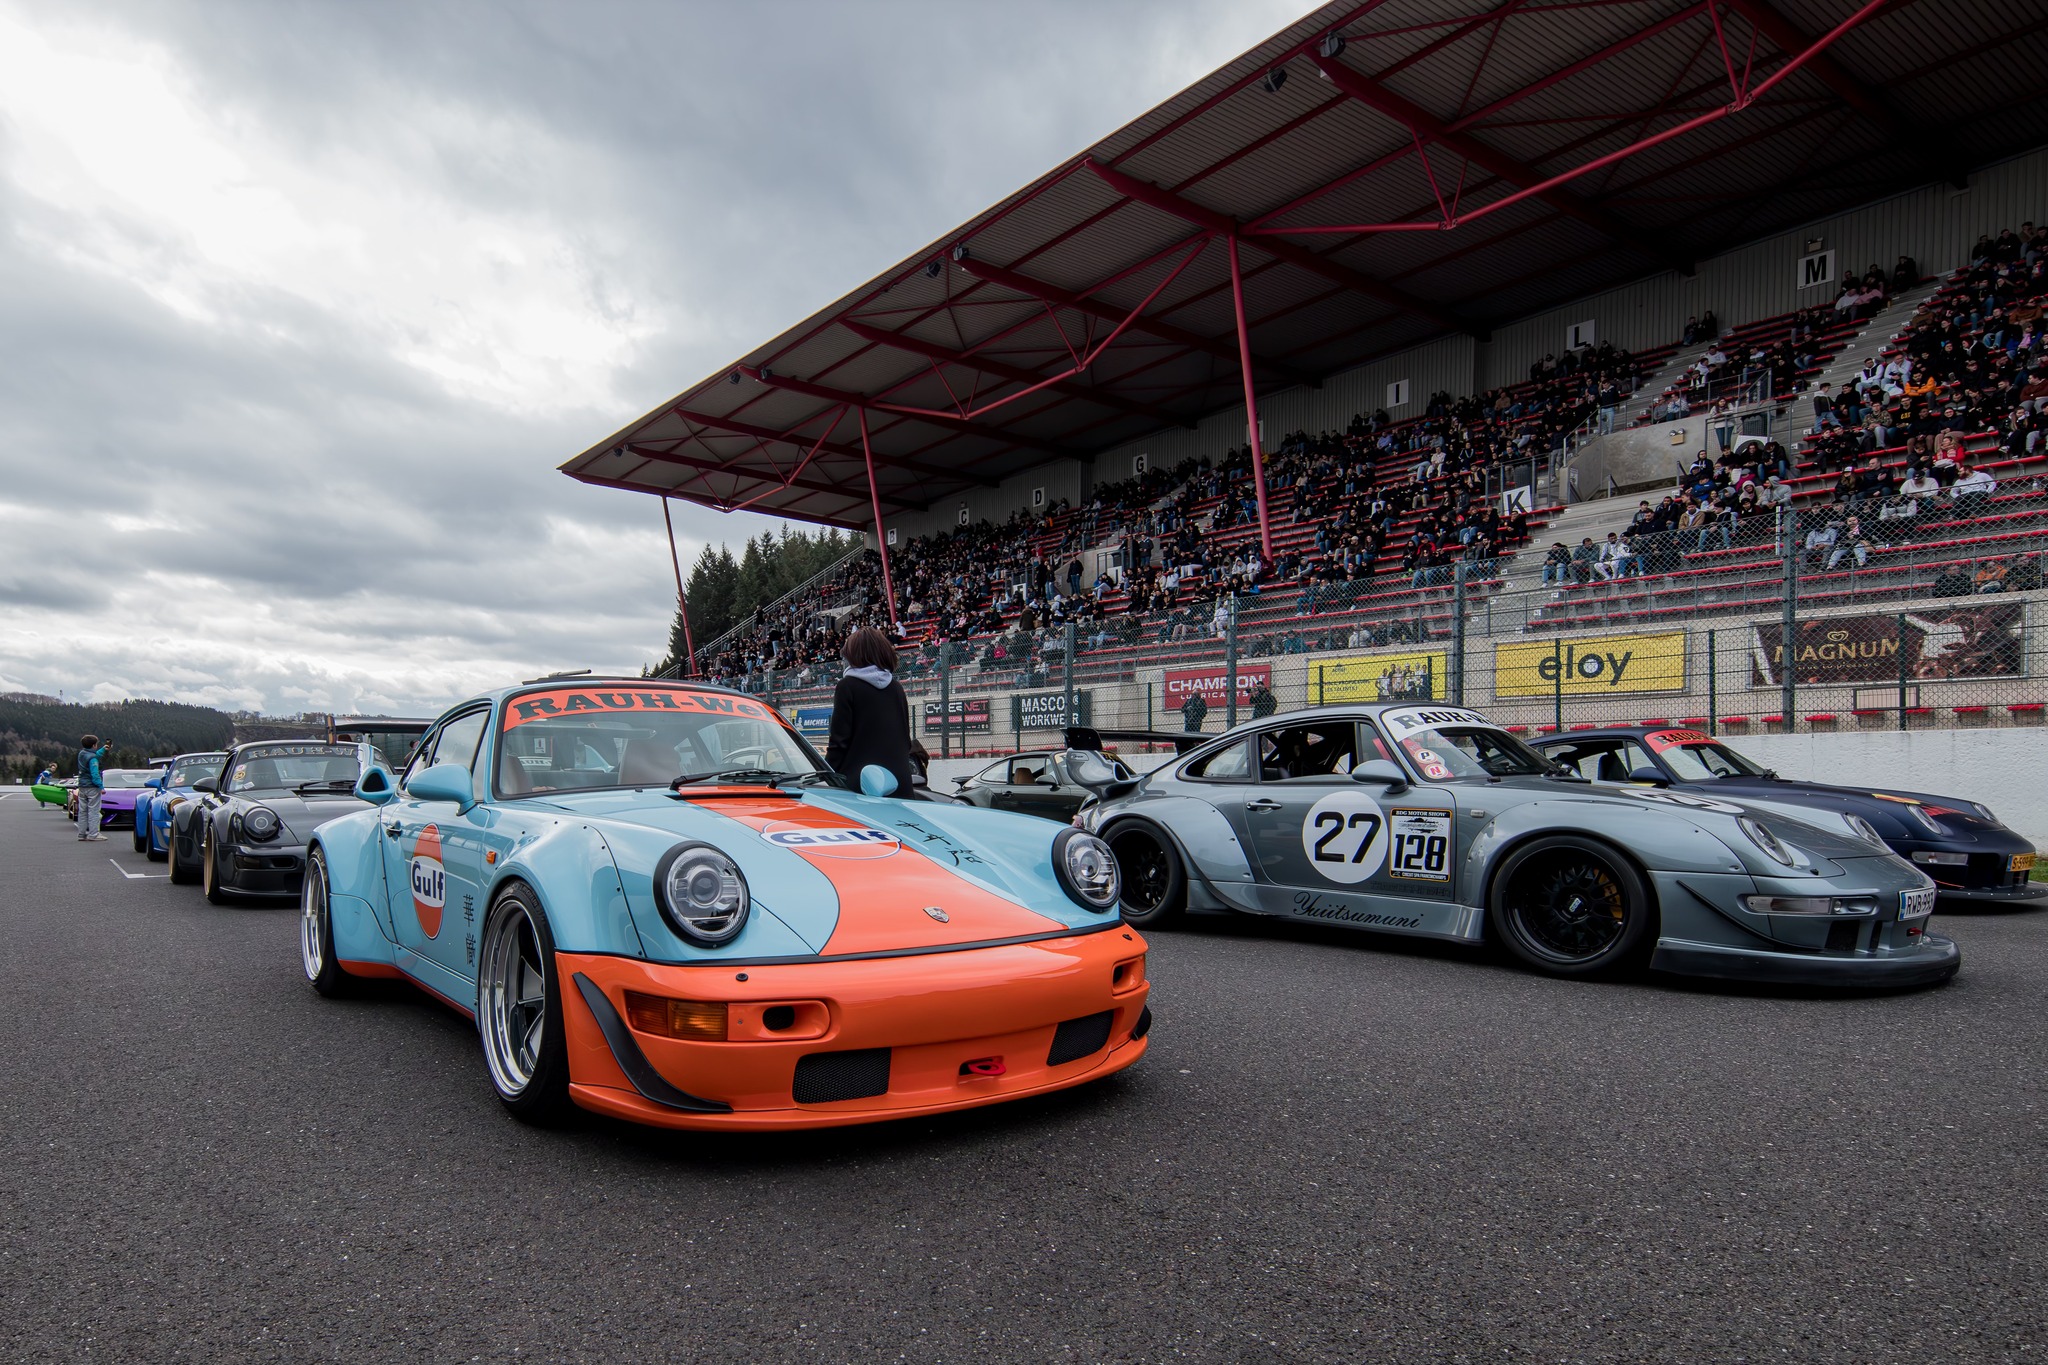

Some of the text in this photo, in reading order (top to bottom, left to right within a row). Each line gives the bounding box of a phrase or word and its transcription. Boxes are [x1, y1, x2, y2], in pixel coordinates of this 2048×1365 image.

[1805, 255, 1827, 284] M
[1573, 326, 1588, 348] L
[1136, 457, 1145, 472] G
[1035, 490, 1042, 504] D
[1507, 490, 1526, 515] K
[961, 511, 967, 524] C
[1538, 644, 1633, 686] eloy
[1168, 675, 1263, 692] CHAMPON
[1180, 691, 1249, 700] LURICATS
[925, 700, 989, 714] CYERNET
[1021, 696, 1068, 713] MASCO
[1021, 713, 1079, 727] WORKWER
[1429, 767, 1442, 776] N
[770, 829, 890, 845] Gulf
[1314, 811, 1382, 864] 27
[1394, 834, 1447, 872] 128
[412, 860, 445, 901] Gulf
